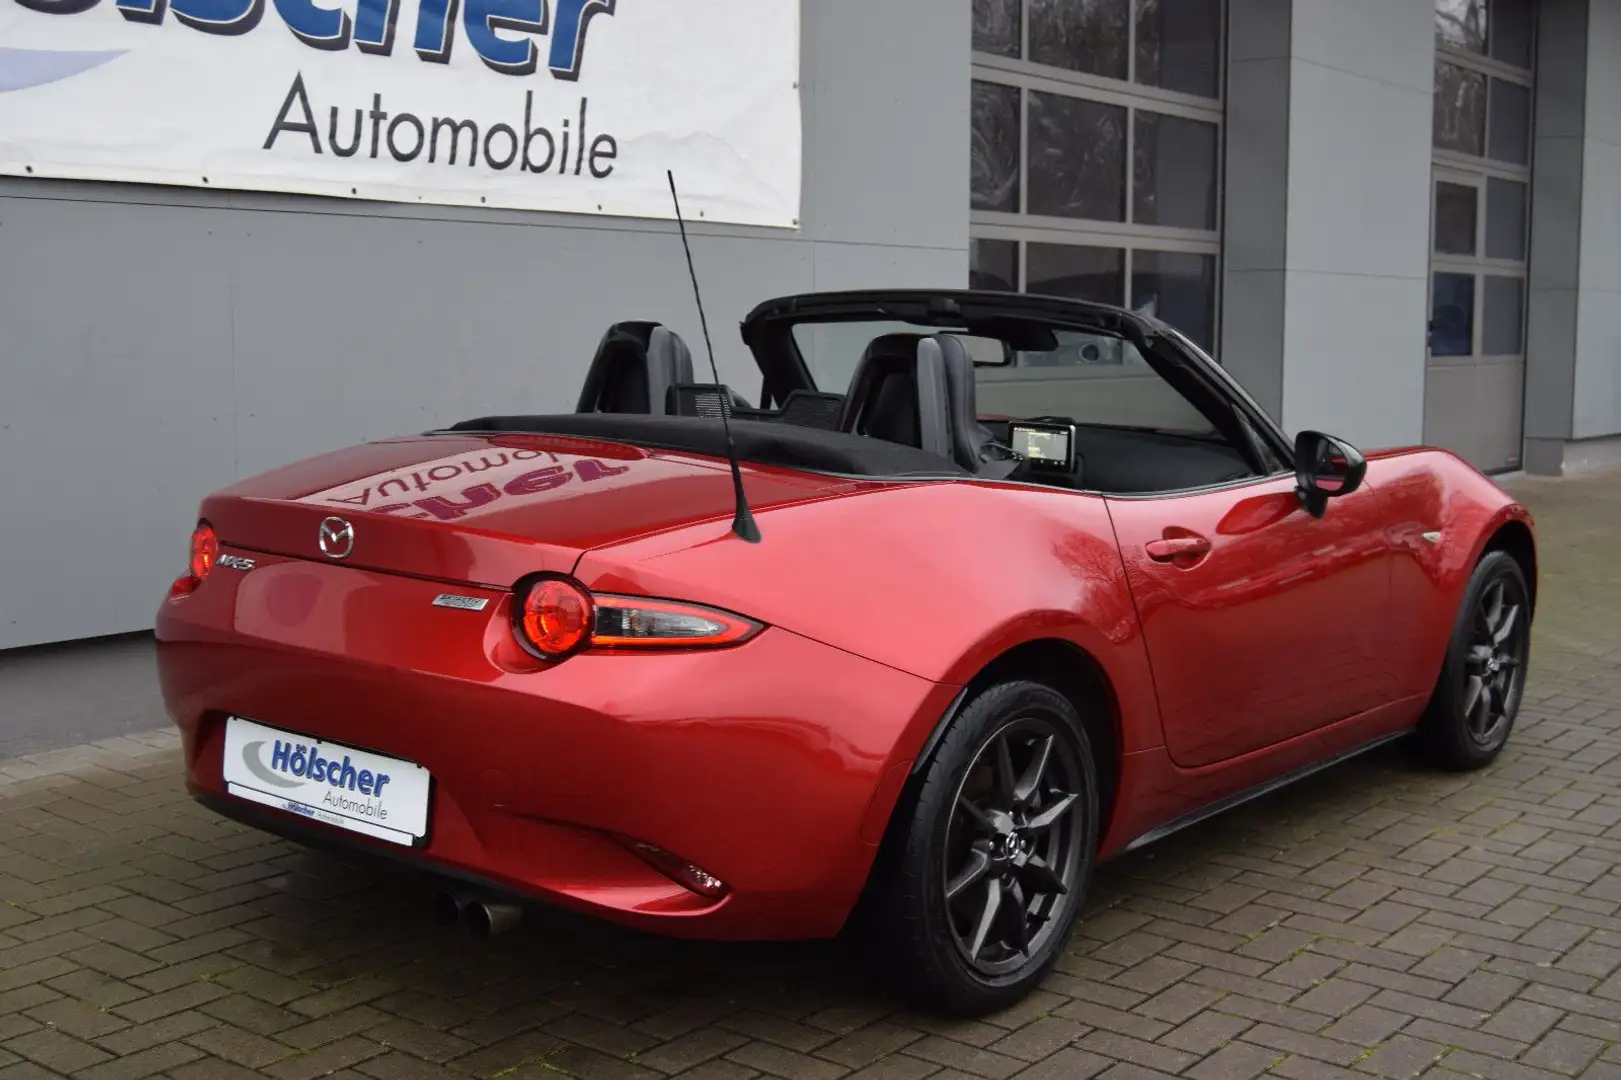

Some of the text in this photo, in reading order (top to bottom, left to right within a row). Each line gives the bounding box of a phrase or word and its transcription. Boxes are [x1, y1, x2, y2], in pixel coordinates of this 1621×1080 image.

[263, 70, 617, 179] Automobile
[271, 739, 390, 798] Hölscher
[322, 790, 389, 820] Automobile
